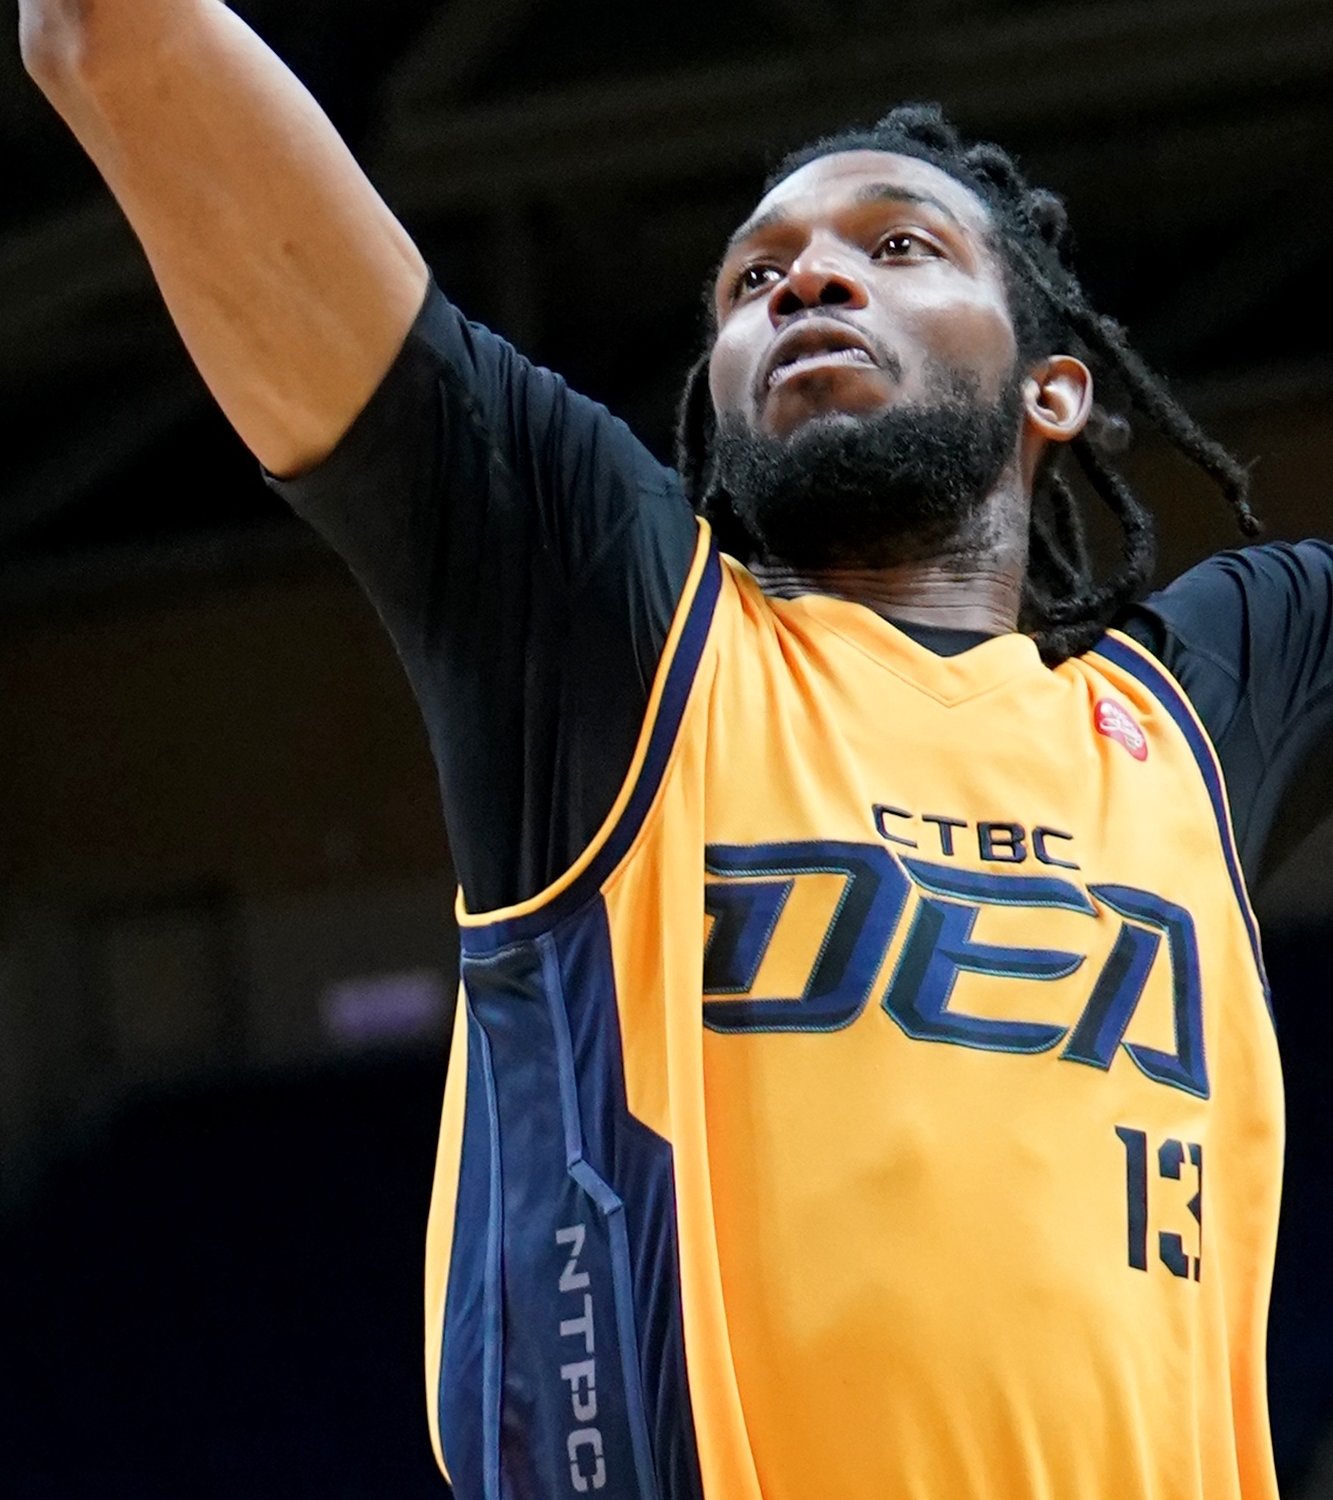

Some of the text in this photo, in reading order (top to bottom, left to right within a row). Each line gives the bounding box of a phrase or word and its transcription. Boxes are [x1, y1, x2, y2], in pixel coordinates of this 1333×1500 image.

[871, 803, 1081, 871] CTBC
[702, 839, 1210, 1100] DEA
[1114, 1125, 1203, 1283] 13
[555, 1223, 607, 1493] NTPC
